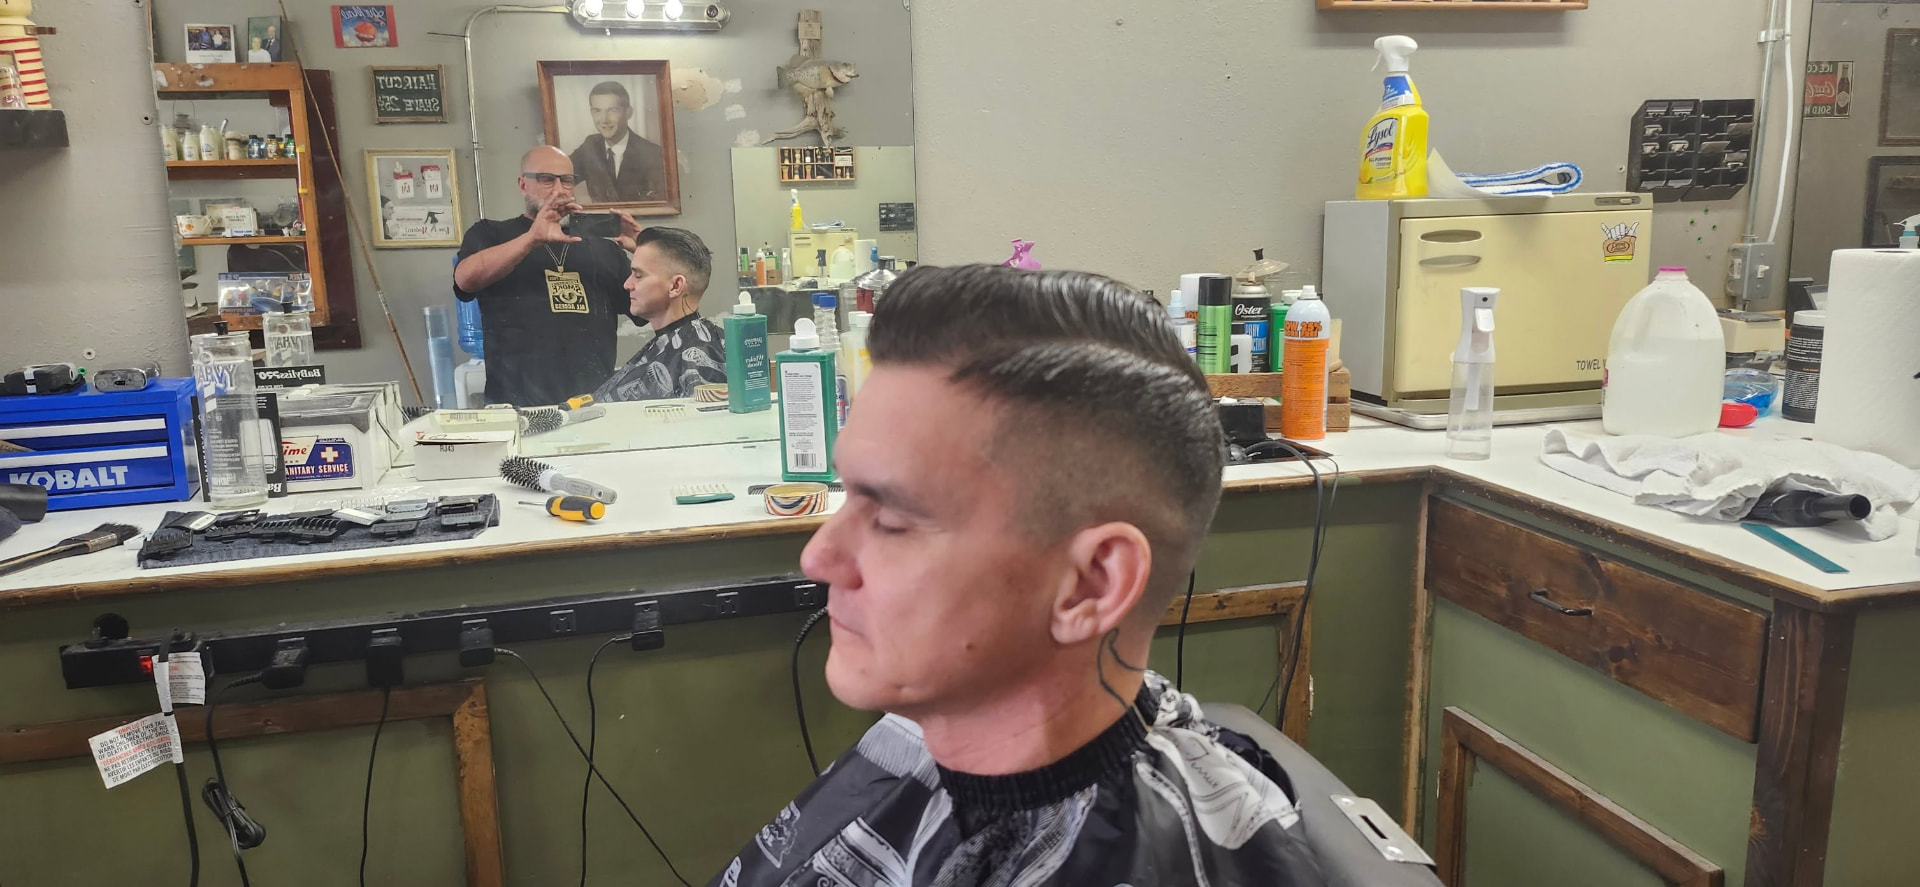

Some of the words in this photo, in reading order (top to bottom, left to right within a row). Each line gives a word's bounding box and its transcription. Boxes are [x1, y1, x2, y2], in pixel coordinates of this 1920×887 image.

[1367, 121, 1395, 148] Lysol
[1235, 304, 1263, 316] Oster
[1300, 320, 1323, 331] 25%
[1576, 359, 1601, 371] TOWEL
[285, 466, 315, 476] ANITARY
[318, 463, 349, 474] SERVICE
[8, 465, 129, 491] KOBALT
[155, 729, 169, 737] SHOC
[109, 736, 119, 744] NOT
[98, 744, 115, 754] WARN
